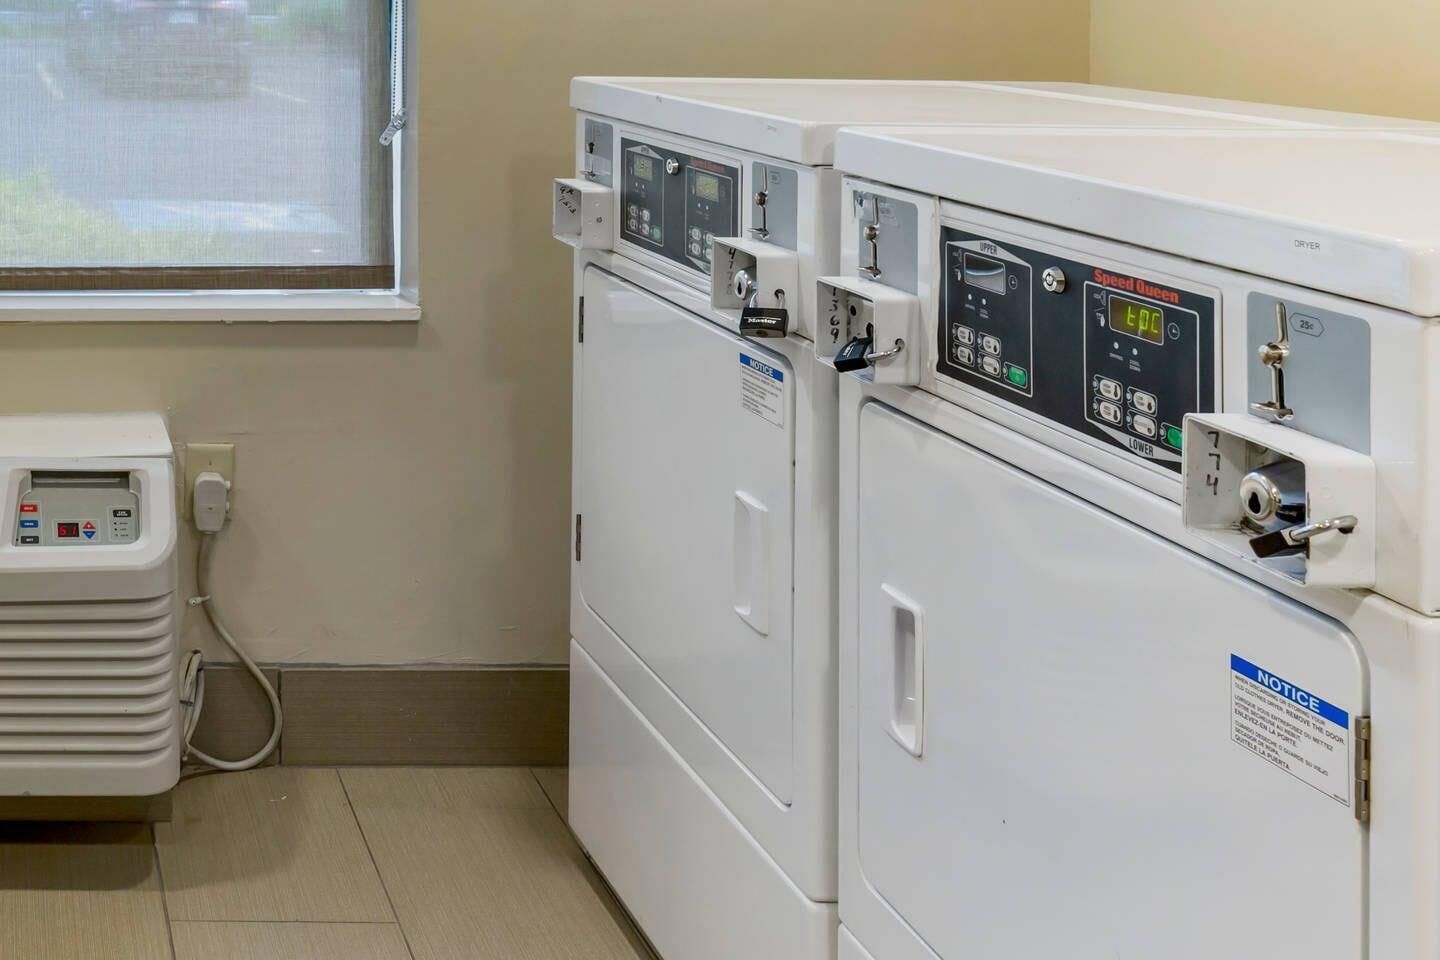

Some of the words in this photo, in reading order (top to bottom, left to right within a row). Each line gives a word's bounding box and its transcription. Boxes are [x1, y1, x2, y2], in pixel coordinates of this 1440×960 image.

[979, 242, 997, 256] UPPER
[1093, 268, 1134, 291] Speed
[1135, 280, 1180, 304] Queen
[750, 358, 774, 377] NOTICE
[1129, 437, 1154, 457] LOWER
[1257, 669, 1320, 713] NOTICE
[1312, 722, 1323, 734] THE
